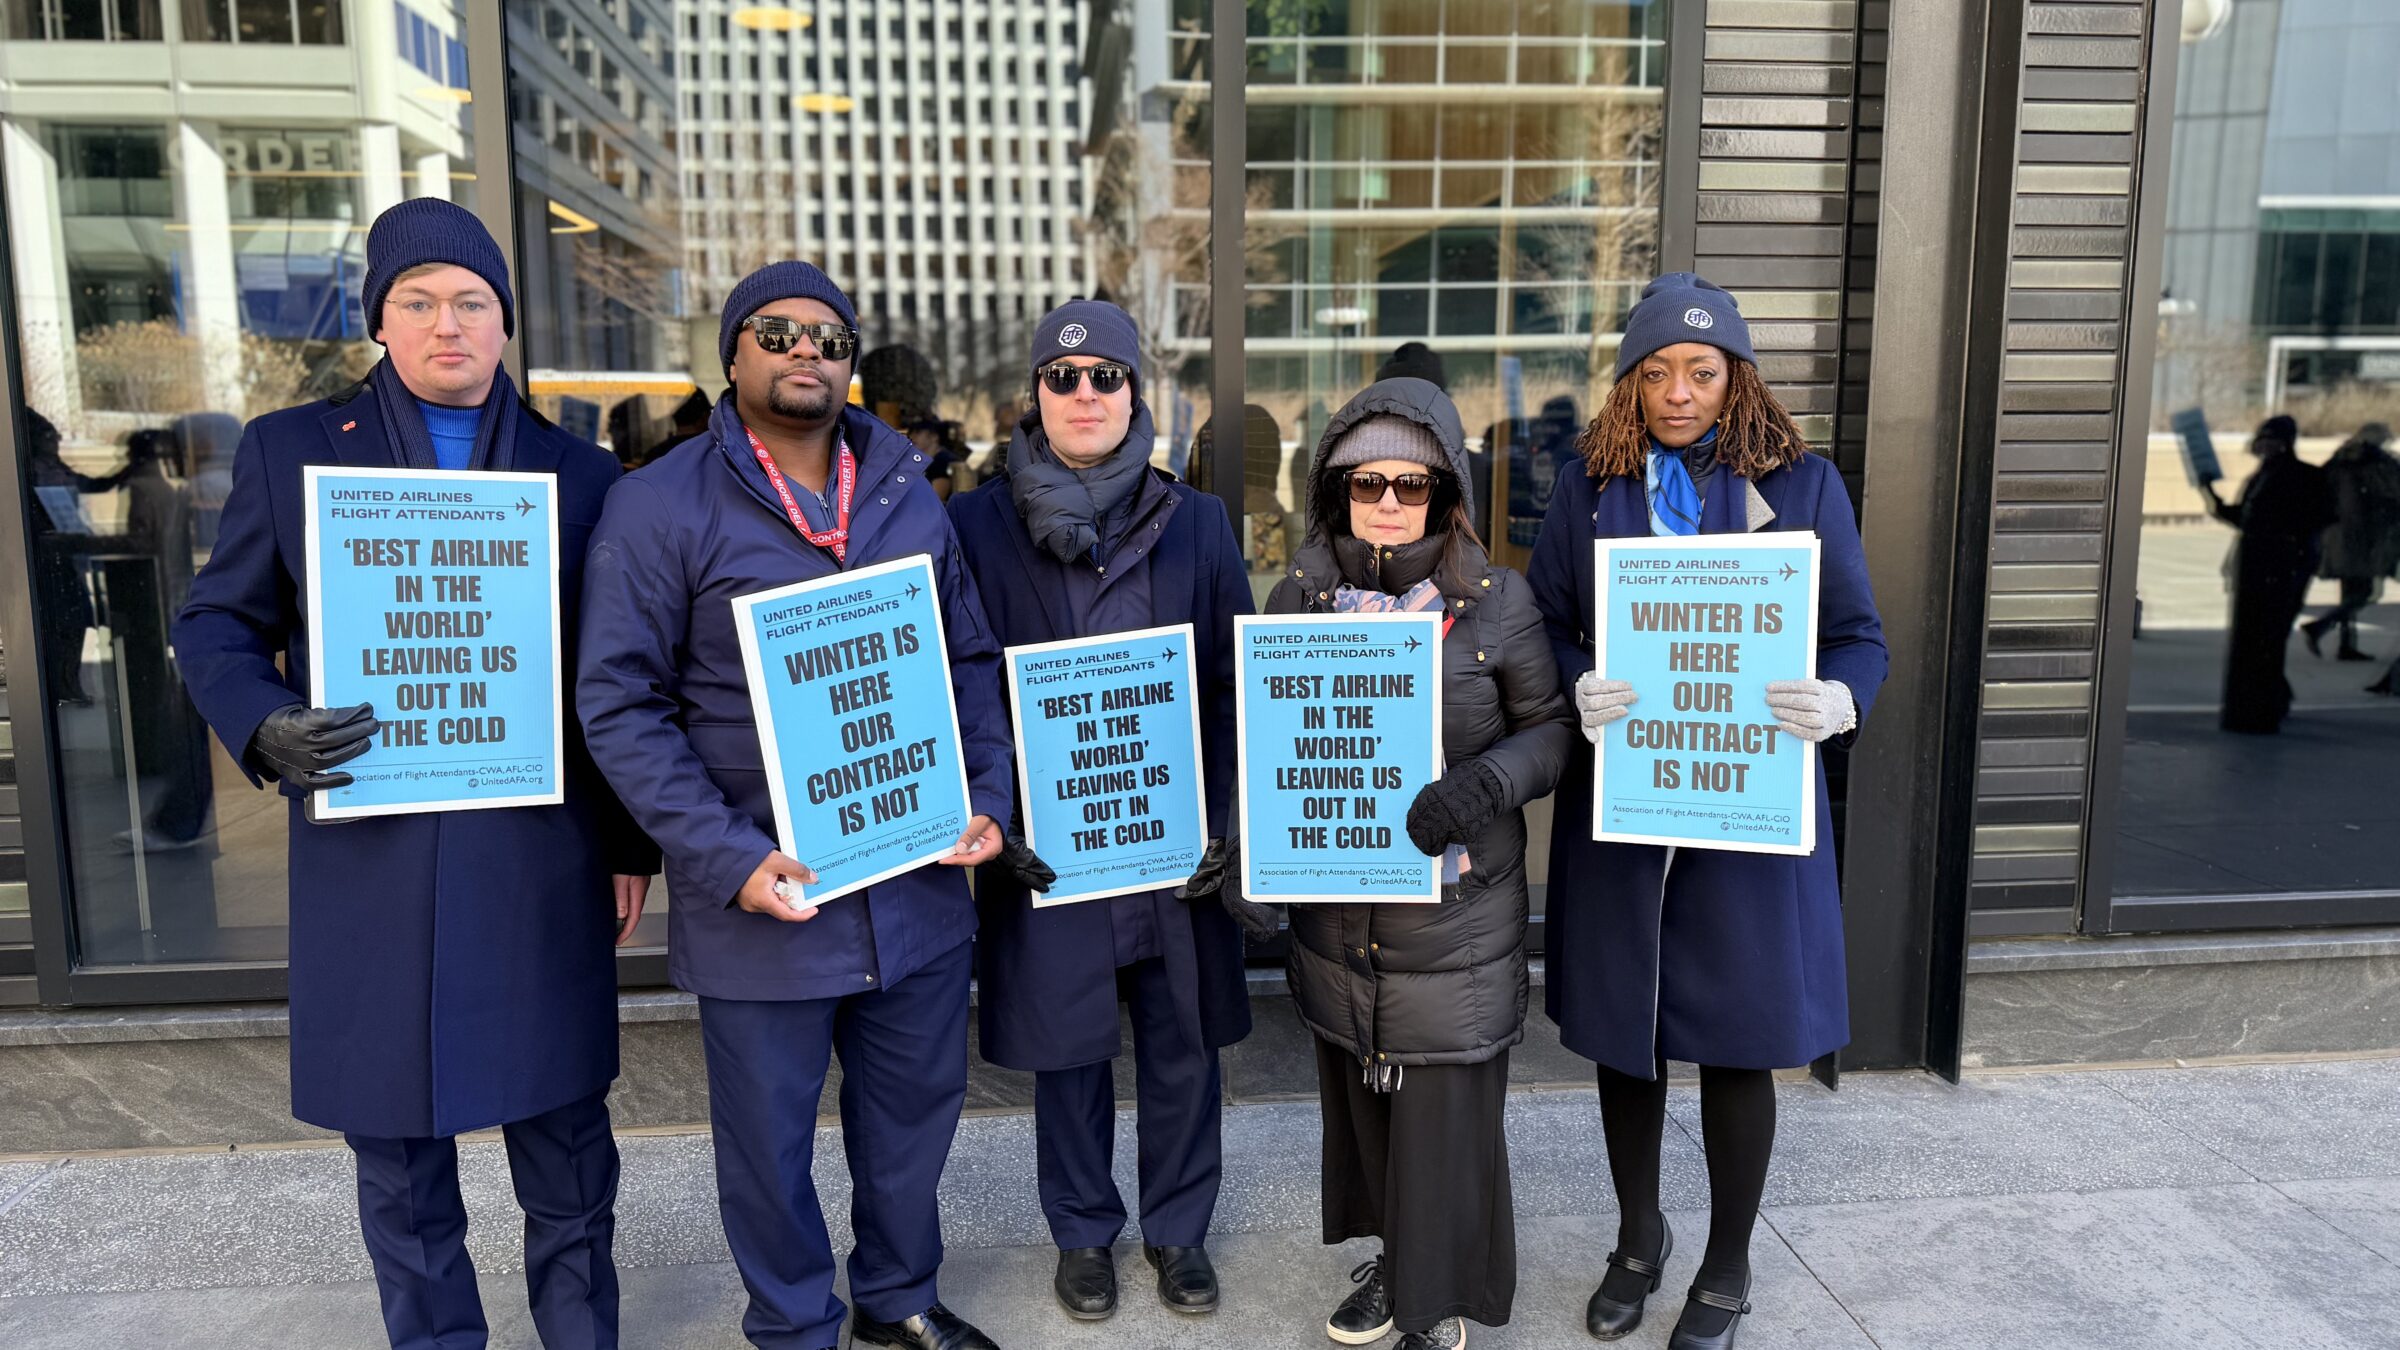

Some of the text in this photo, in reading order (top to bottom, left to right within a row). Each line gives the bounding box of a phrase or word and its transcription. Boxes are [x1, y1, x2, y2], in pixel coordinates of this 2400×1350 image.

[331, 490, 472, 502] UNITED AIRLINES
[766, 462, 778, 477] NO
[775, 479, 793, 506] MORE
[842, 468, 852, 513] WHATEVER
[331, 508, 505, 520] FLIGHT ATTENDANTS
[430, 539, 528, 566] AIRLINE
[1619, 560, 1739, 569] UNITED AIRLINES
[395, 575, 481, 602] IN THE
[1618, 575, 1768, 585] FLIGHT ATTENDANTS
[763, 589, 872, 623] UNITED AIRLINES
[766, 599, 899, 640] FLIGHT ATTENDANTS
[1631, 602, 1782, 634] WINTER IS
[1253, 634, 1367, 644] UNITED AIRLINES
[362, 645, 517, 675] LEAVING US
[783, 623, 919, 685] WINTER IS
[1025, 650, 1129, 671] UNITED AIRLINES
[1253, 648, 1395, 659] FLIGHT ATTENDANTS
[1669, 642, 1739, 673] HERE
[1026, 661, 1155, 685] FLIGHT ATTENDANTS
[1332, 674, 1414, 698] AIRLINE
[396, 681, 486, 711] OUT IN
[828, 670, 893, 715] HERE
[1101, 681, 1174, 711] AIRLINE
[1673, 681, 1732, 712] OUR
[1076, 713, 1140, 742] IN THE
[1303, 705, 1373, 729] IN THE
[378, 716, 505, 747] THE COLD
[840, 711, 895, 753] OUR
[1626, 719, 1781, 754] CONTRACT
[354, 773, 390, 782] ociation
[393, 771, 402, 779] of
[405, 770, 427, 780] Flight
[481, 775, 543, 785] UnitedAFA.org
[806, 737, 936, 805] CONTRACT
[1056, 764, 1169, 800] LEAVING US
[1276, 766, 1401, 789] LEAVING US
[1653, 758, 1749, 793] IS NOT
[838, 781, 919, 836] IS NOT
[1082, 794, 1149, 823] OUT IN
[1303, 796, 1375, 819] OUT IN
[1612, 804, 1653, 813] Association
[1665, 807, 1685, 817] Flight
[914, 828, 960, 848] UnitedAFA.org
[1071, 819, 1164, 852] THE COLD
[1287, 826, 1391, 849] THE COLD
[1732, 822, 1790, 835] UnitedAFA.org
[849, 852, 856, 861] of
[857, 847, 875, 858] Flight
[1148, 861, 1194, 873] UnitedAFA.org
[1056, 871, 1083, 879] sociation
[1093, 866, 1110, 874] Flight
[1259, 868, 1298, 876] Association
[1308, 868, 1327, 877] Flight
[1370, 877, 1421, 886] UnitedAFA.org
